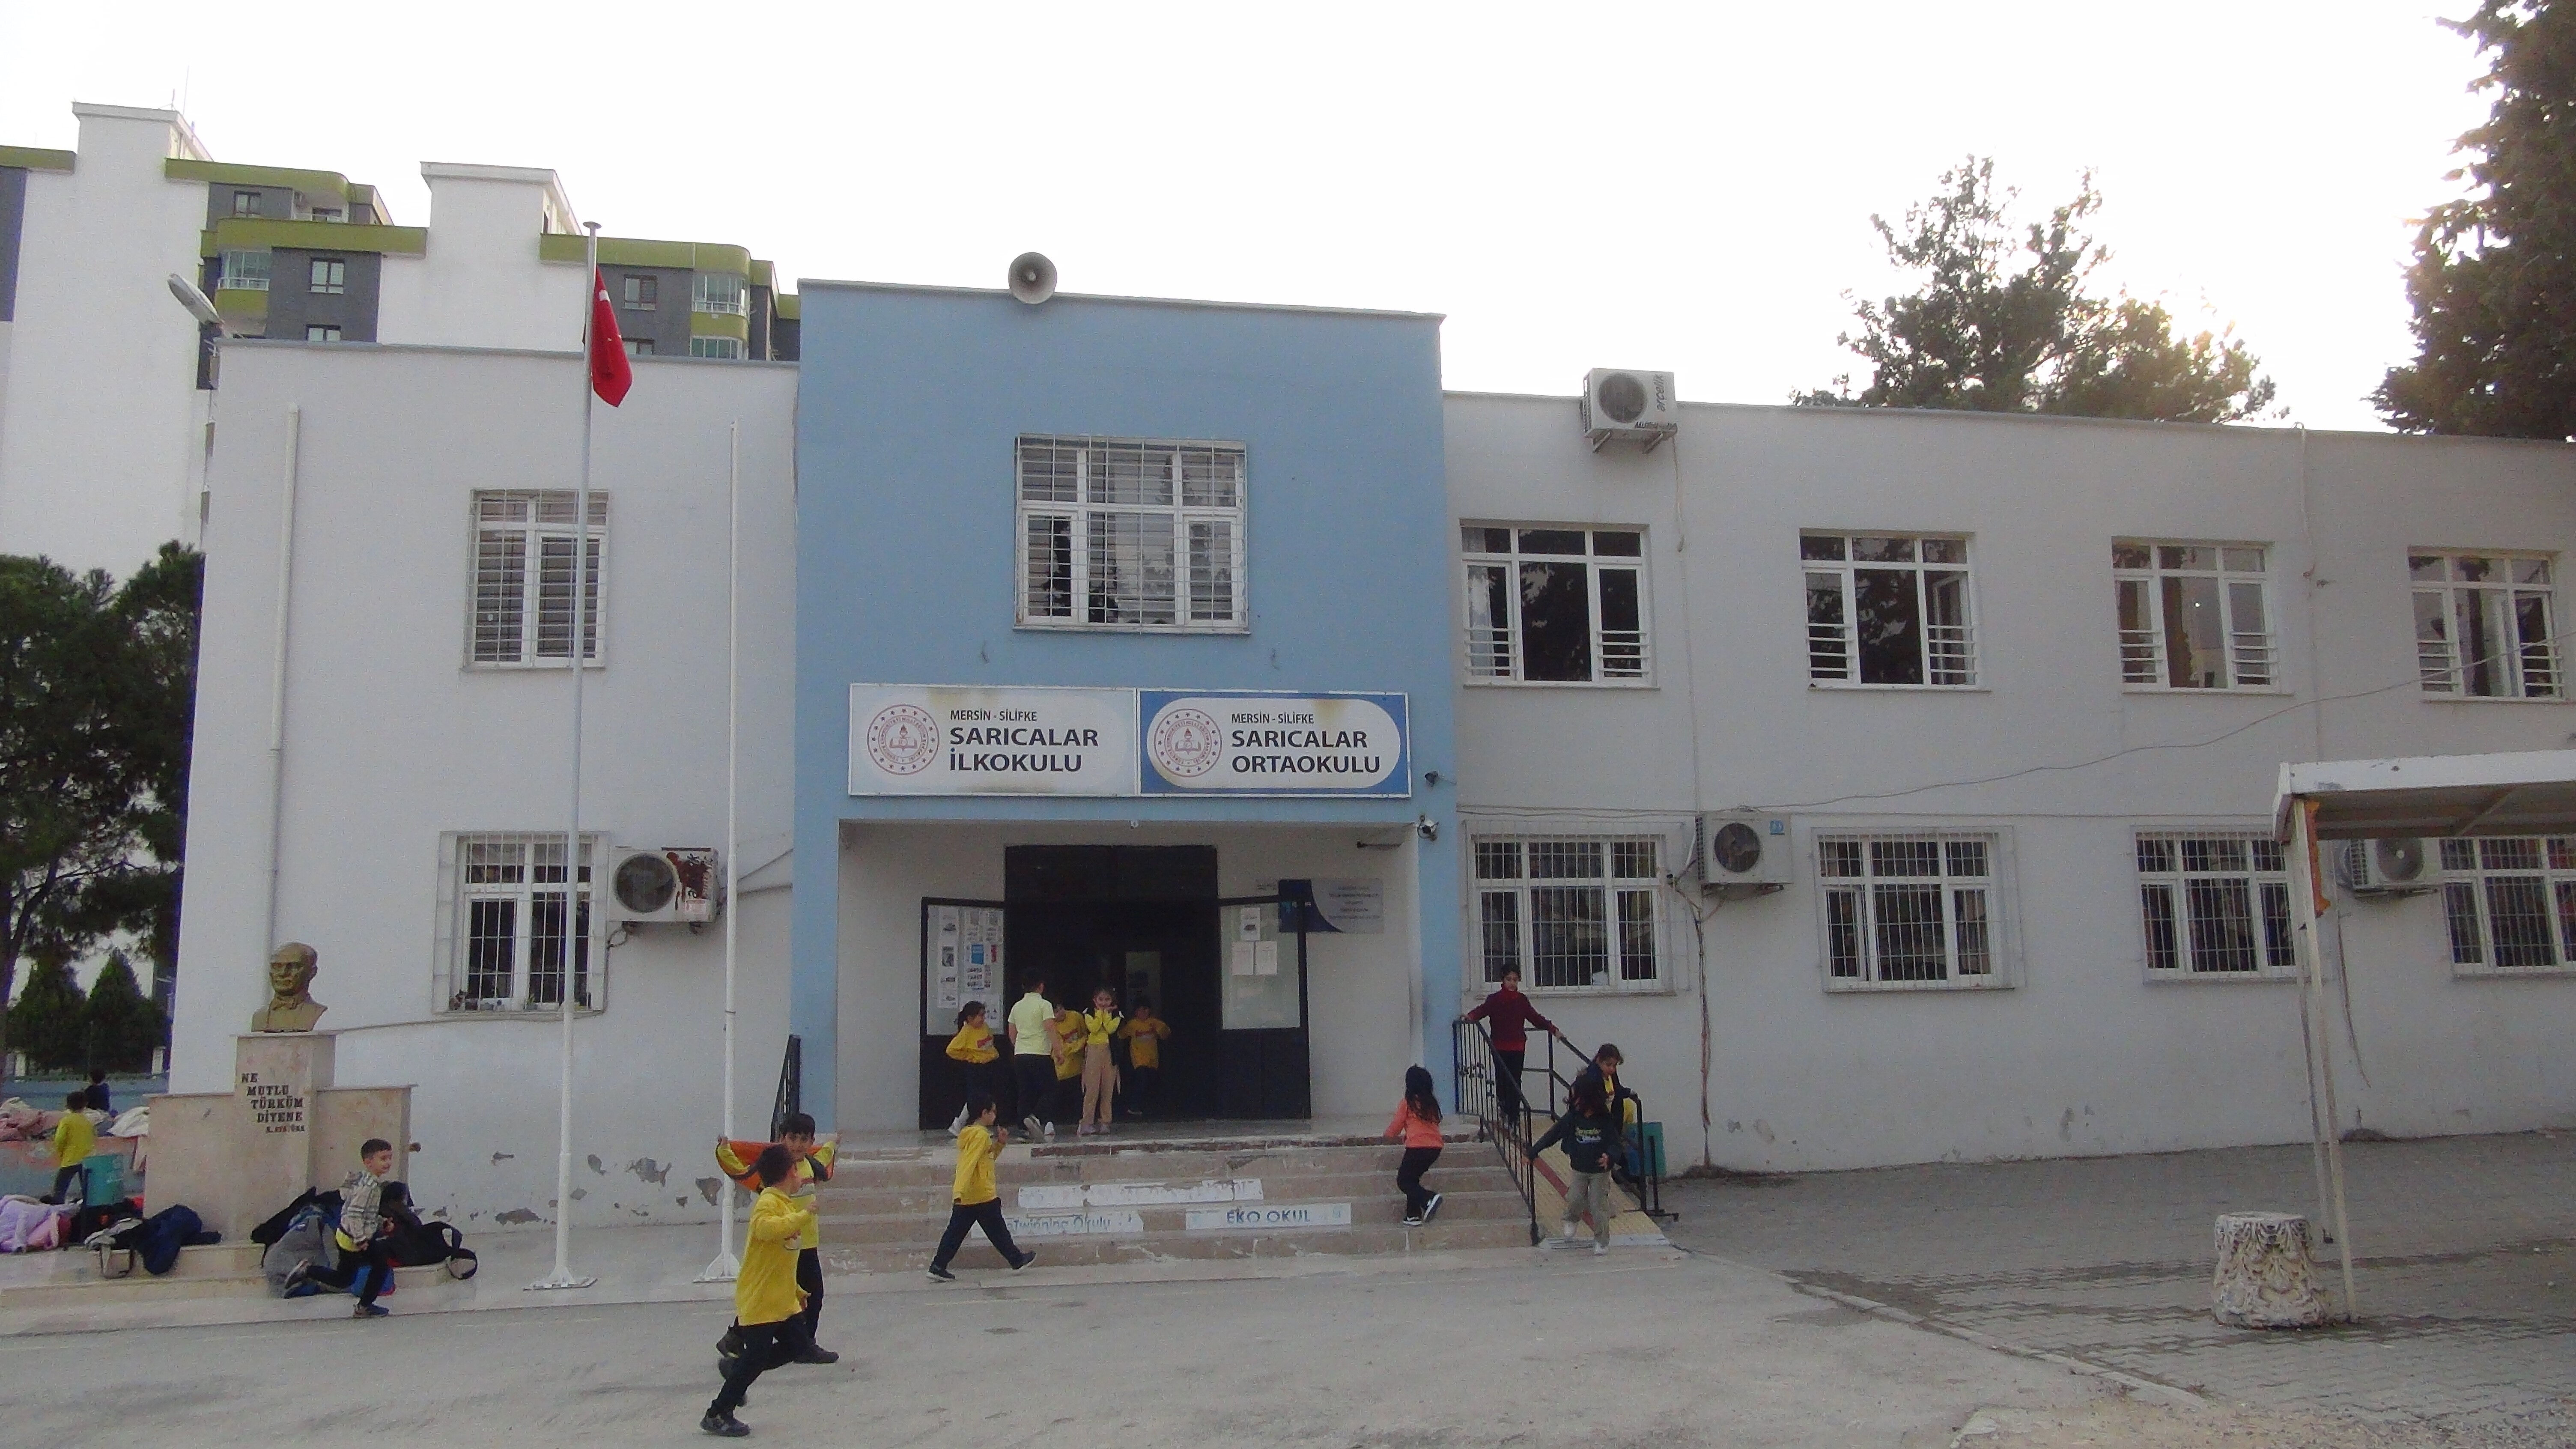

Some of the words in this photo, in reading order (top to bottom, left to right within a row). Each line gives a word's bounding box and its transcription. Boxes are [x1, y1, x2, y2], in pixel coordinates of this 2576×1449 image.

[950, 708, 990, 721] MERSİN
[999, 708, 1038, 722] SİLİFKE
[1231, 710, 1270, 724] MERSİN
[1278, 711, 1314, 724] SİLİFKE
[950, 727, 1099, 746] SARICALAR
[1231, 730, 1368, 748] SARICALAR
[950, 747, 1082, 772] İLKOKULU
[1231, 755, 1380, 773] ORTAOKULU
[242, 1073, 258, 1083] NE
[247, 1085, 289, 1096] MUTLU
[250, 1096, 304, 1109] TÜRKÜM
[257, 1110, 302, 1123] DİYENE
[1227, 1210, 1260, 1223] EKO
[1266, 1210, 1310, 1222] OKUL
